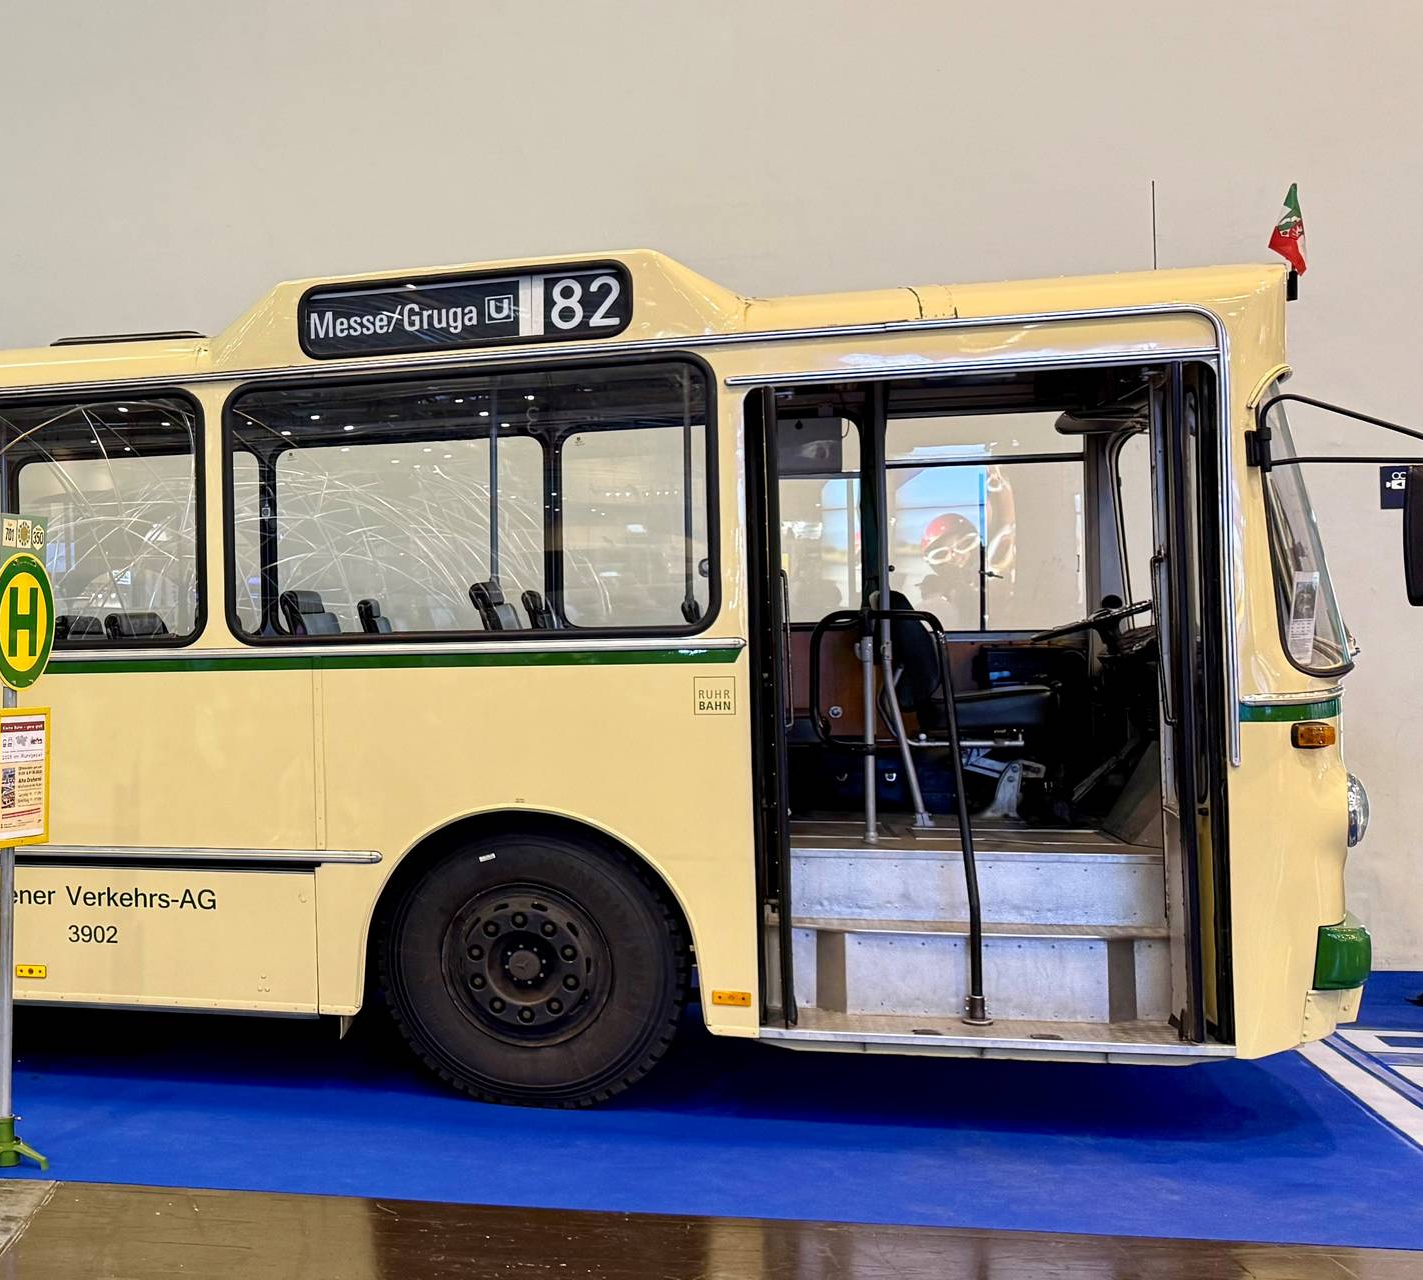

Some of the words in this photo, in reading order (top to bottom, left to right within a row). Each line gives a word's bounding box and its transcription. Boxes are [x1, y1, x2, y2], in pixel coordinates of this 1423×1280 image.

[309, 304, 478, 339] Messe/Gruga
[550, 275, 622, 330] 82
[32, 531, 44, 545] 350
[8, 587, 39, 657] H
[698, 689, 731, 699] RUHR
[699, 701, 731, 711] BAHN
[65, 885, 217, 910] Verkehrs-AG
[68, 924, 119, 944] 3902
